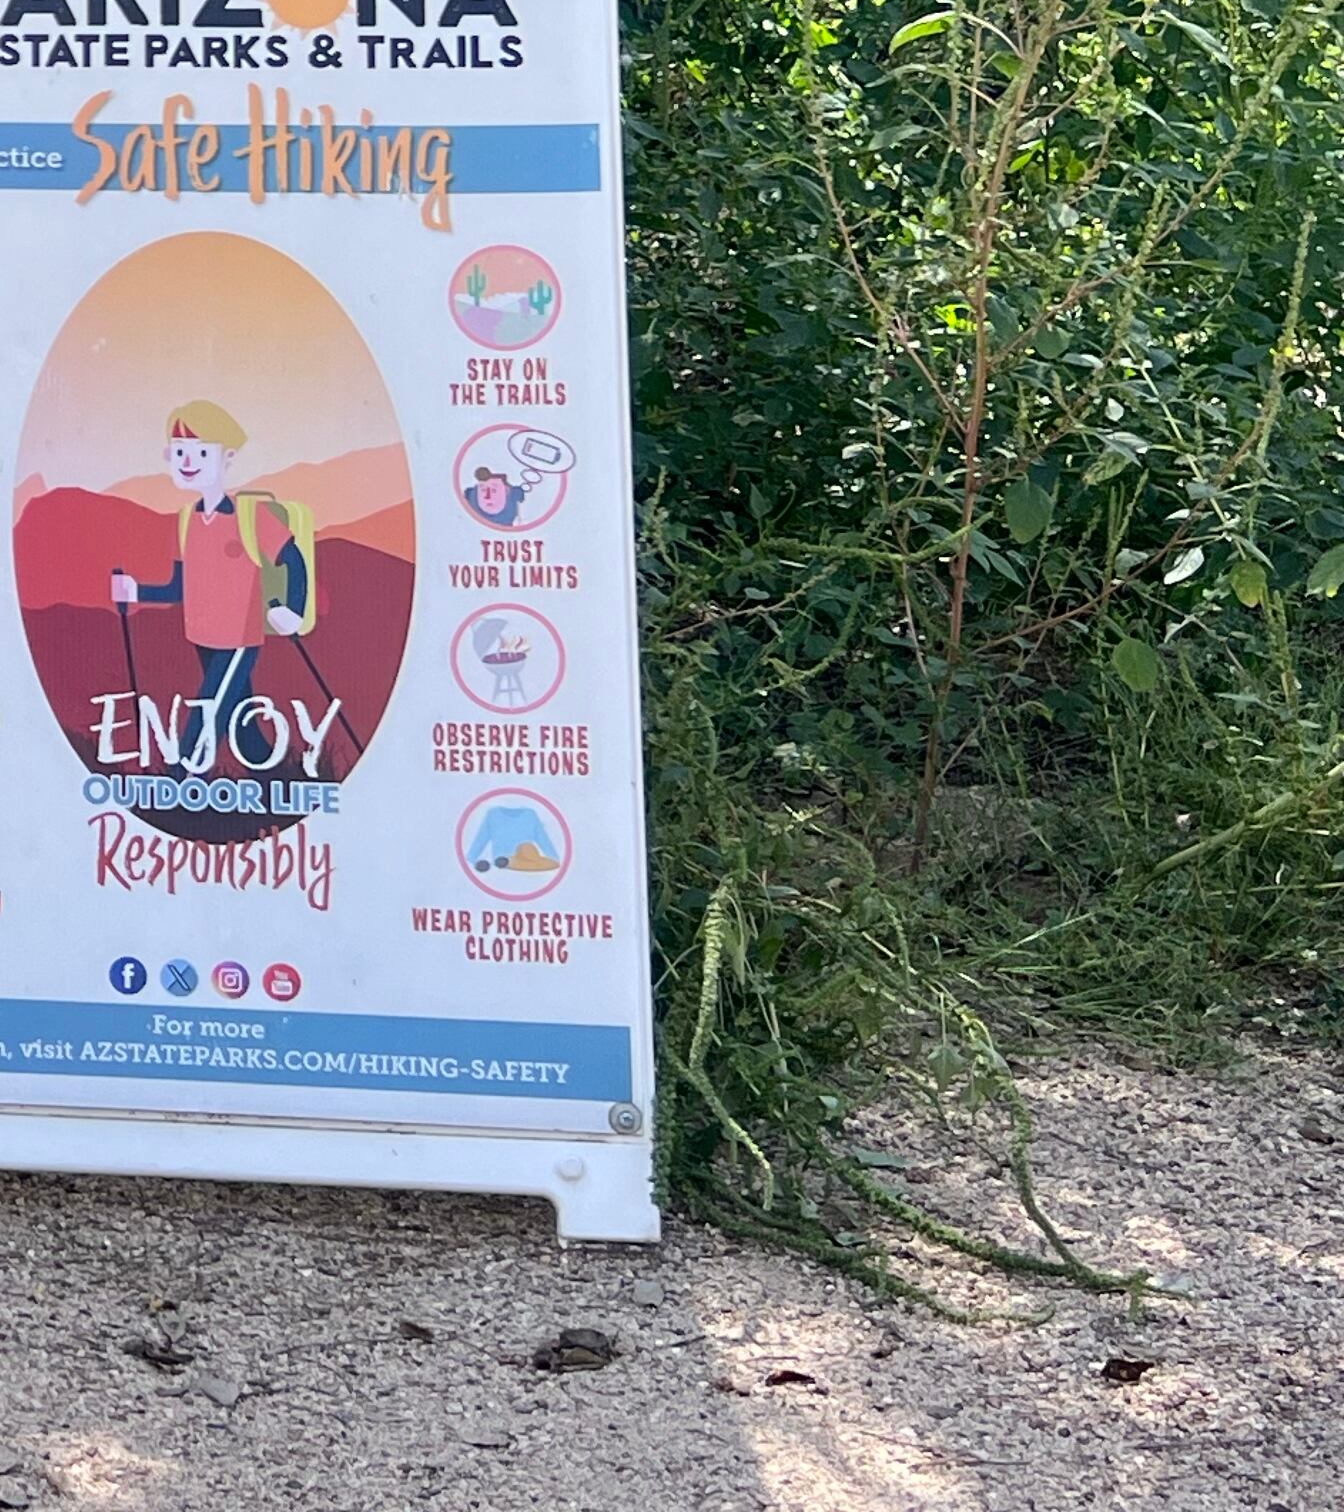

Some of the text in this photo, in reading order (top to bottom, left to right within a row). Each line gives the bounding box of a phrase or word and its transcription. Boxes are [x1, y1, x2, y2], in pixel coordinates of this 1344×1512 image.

[145, 34, 288, 68] PARKS
[309, 34, 342, 68] &
[358, 35, 523, 68] TRAILS
[71, 88, 221, 205] Safe
[229, 82, 453, 233] Hiking
[467, 358, 546, 381] STAY ON
[450, 383, 566, 405] THE TRAILS
[481, 540, 543, 563] TRUST
[449, 565, 577, 589] YOUR LIMITS
[90, 691, 341, 778] ENJOY
[433, 723, 588, 748] OBSERVE FIRE
[434, 749, 589, 776] RESTRICTIONS
[83, 773, 340, 814] OUTDOOR LIFE
[87, 811, 336, 911] Responsibly
[412, 908, 612, 938] WEAR PROTECTIVE
[466, 936, 568, 964] CLOTHING
[152, 1014, 265, 1038] For more
[19, 1039, 73, 1061] visit
[79, 1041, 570, 1085] AZSTATEPARKS.COM/HIKING-SAFETY
